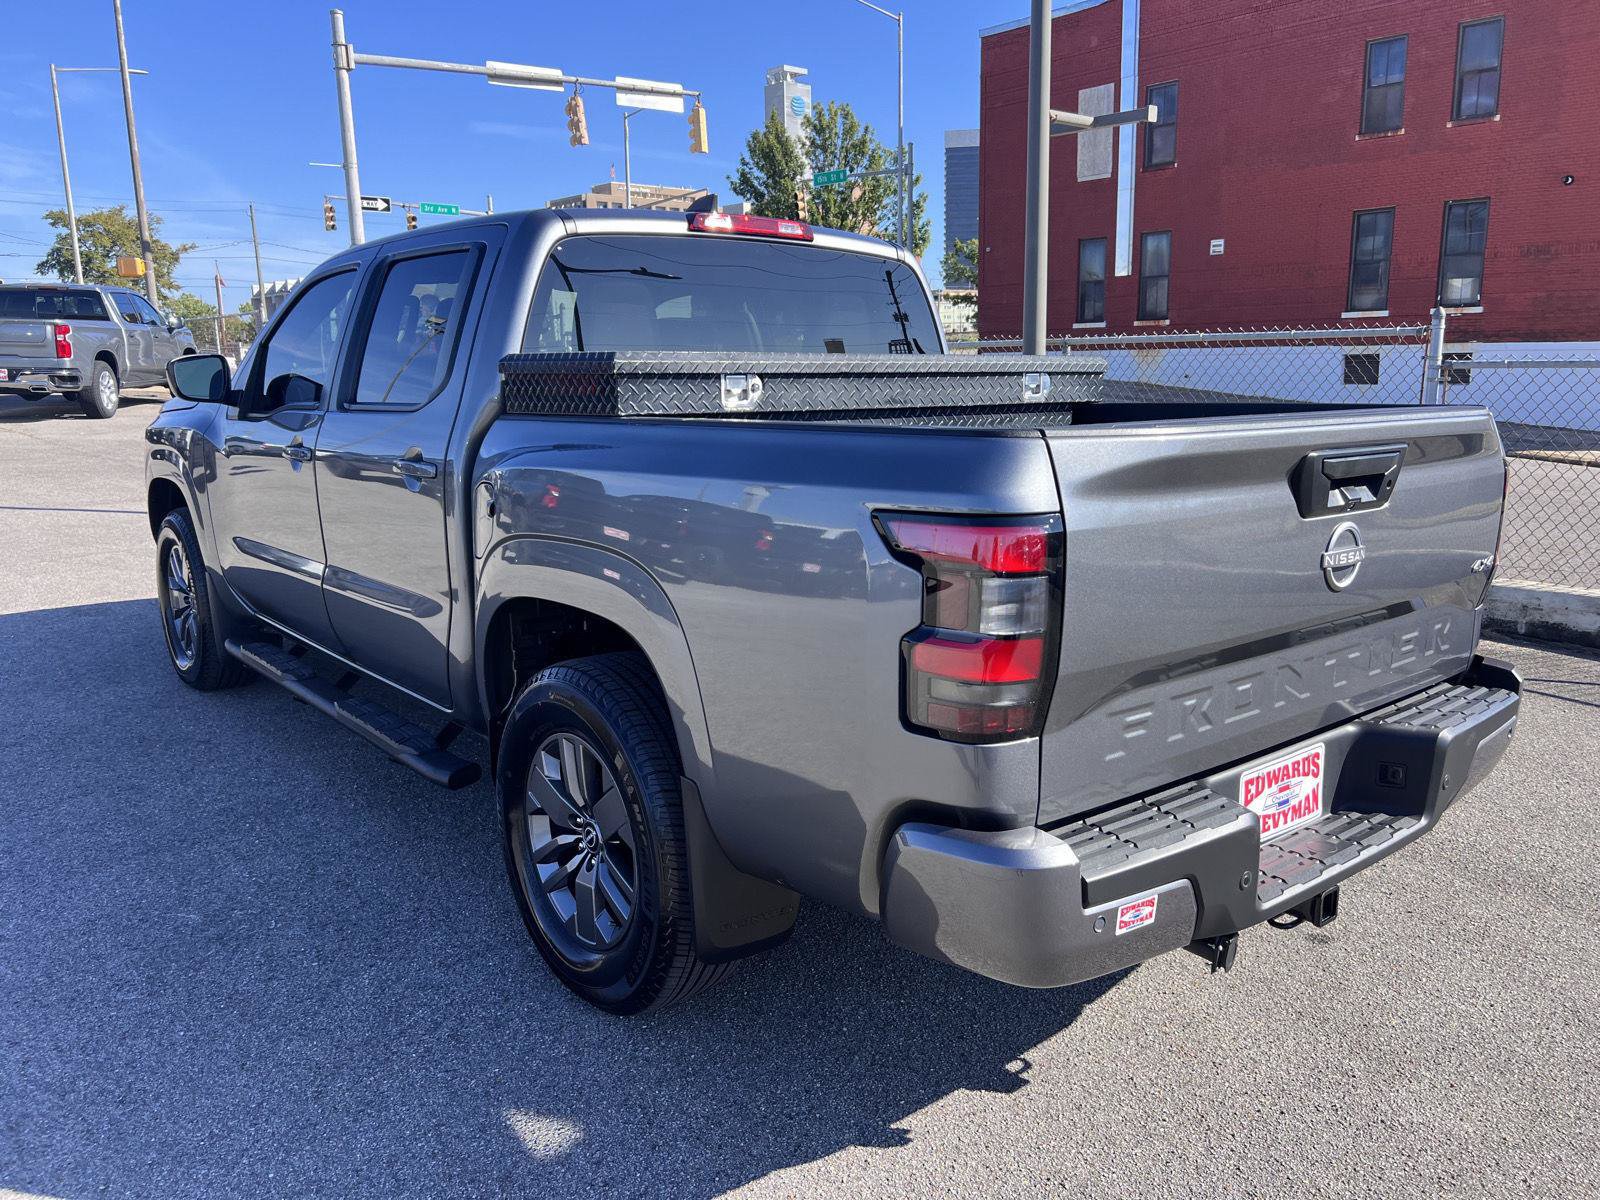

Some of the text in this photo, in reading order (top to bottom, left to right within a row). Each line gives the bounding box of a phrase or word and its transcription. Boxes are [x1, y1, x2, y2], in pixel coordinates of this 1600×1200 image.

[424, 204, 434, 212] 3rd
[437, 206, 448, 214] Ave
[1325, 549, 1365, 566] NISSAN
[1105, 623, 1451, 761] FRONTIER
[1244, 752, 1320, 807] EDWARDS
[1259, 782, 1320, 833] EVYMAN
[1120, 897, 1155, 916] EDWARDS
[1119, 911, 1152, 929] CHEVYMAN
